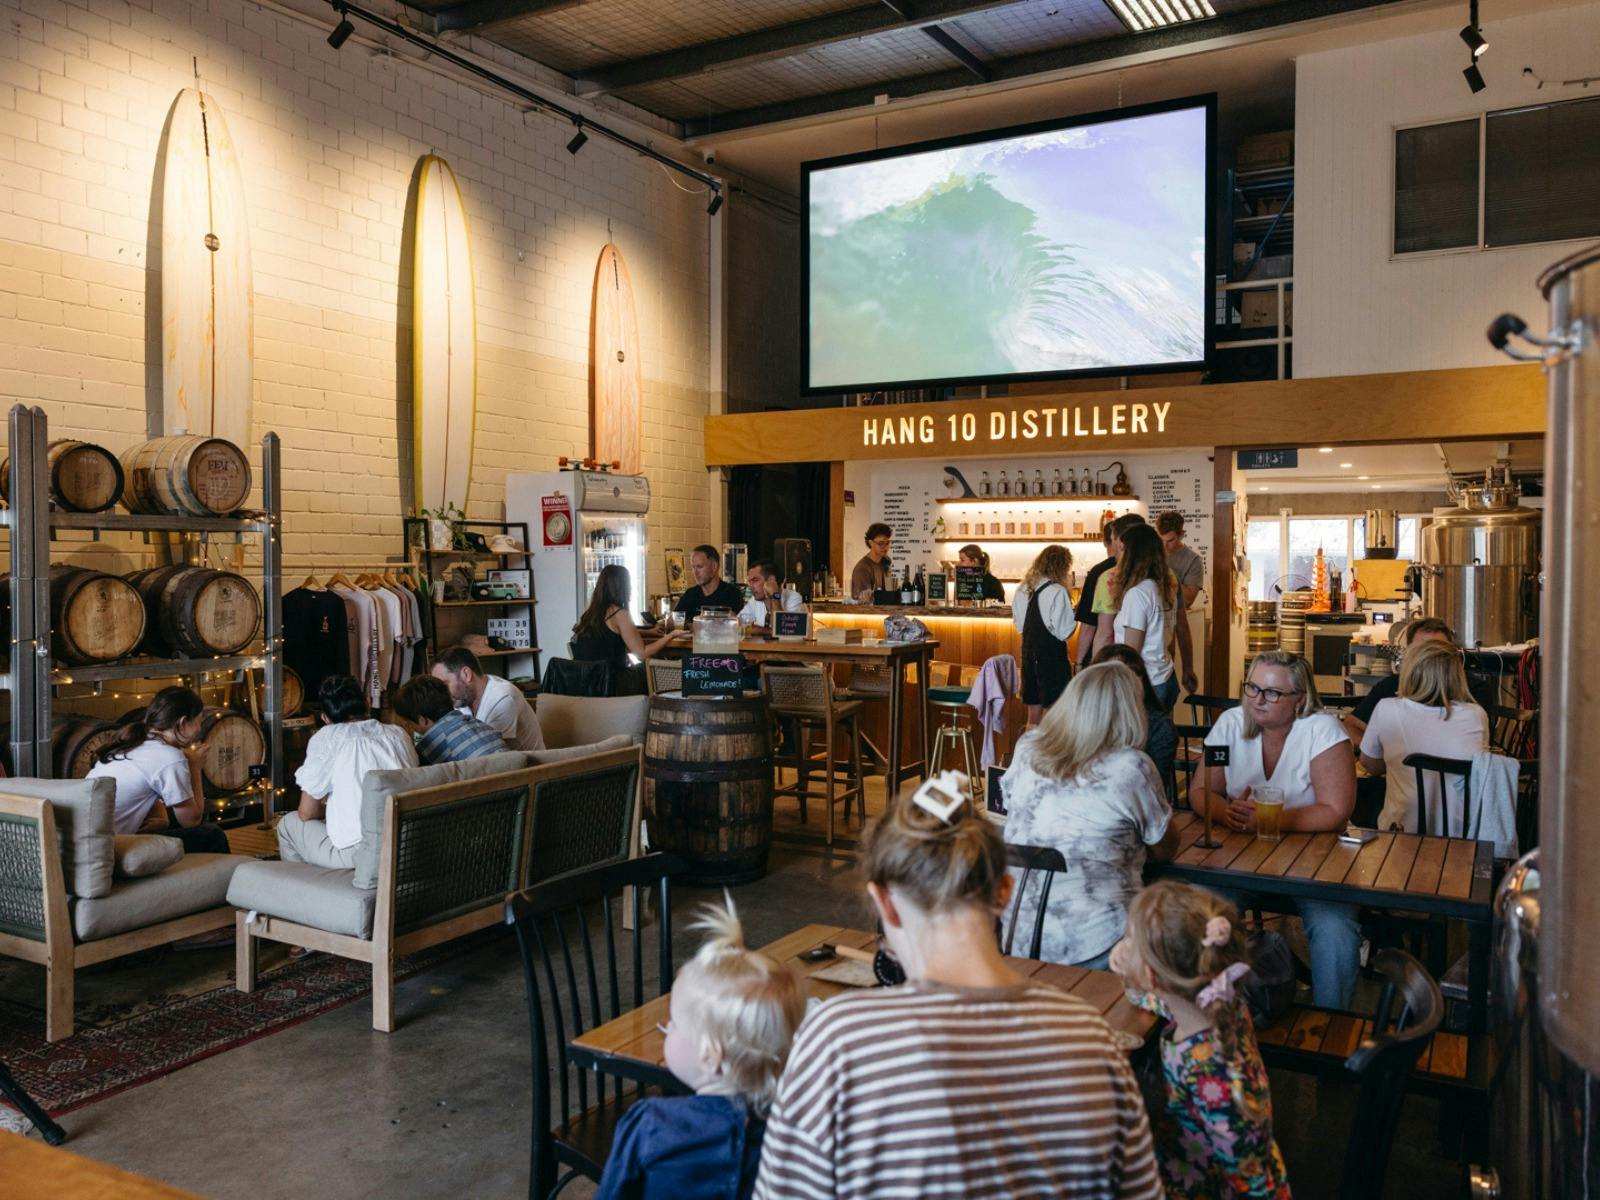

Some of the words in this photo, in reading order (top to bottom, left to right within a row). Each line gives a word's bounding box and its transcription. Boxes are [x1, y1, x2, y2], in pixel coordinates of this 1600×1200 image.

[863, 415, 934, 446] HANG
[948, 413, 976, 442] 10
[990, 402, 1171, 440] DISTILLERY
[689, 657, 721, 669] FREE
[684, 670, 710, 679] FRESH
[1214, 751, 1226, 761] 32
